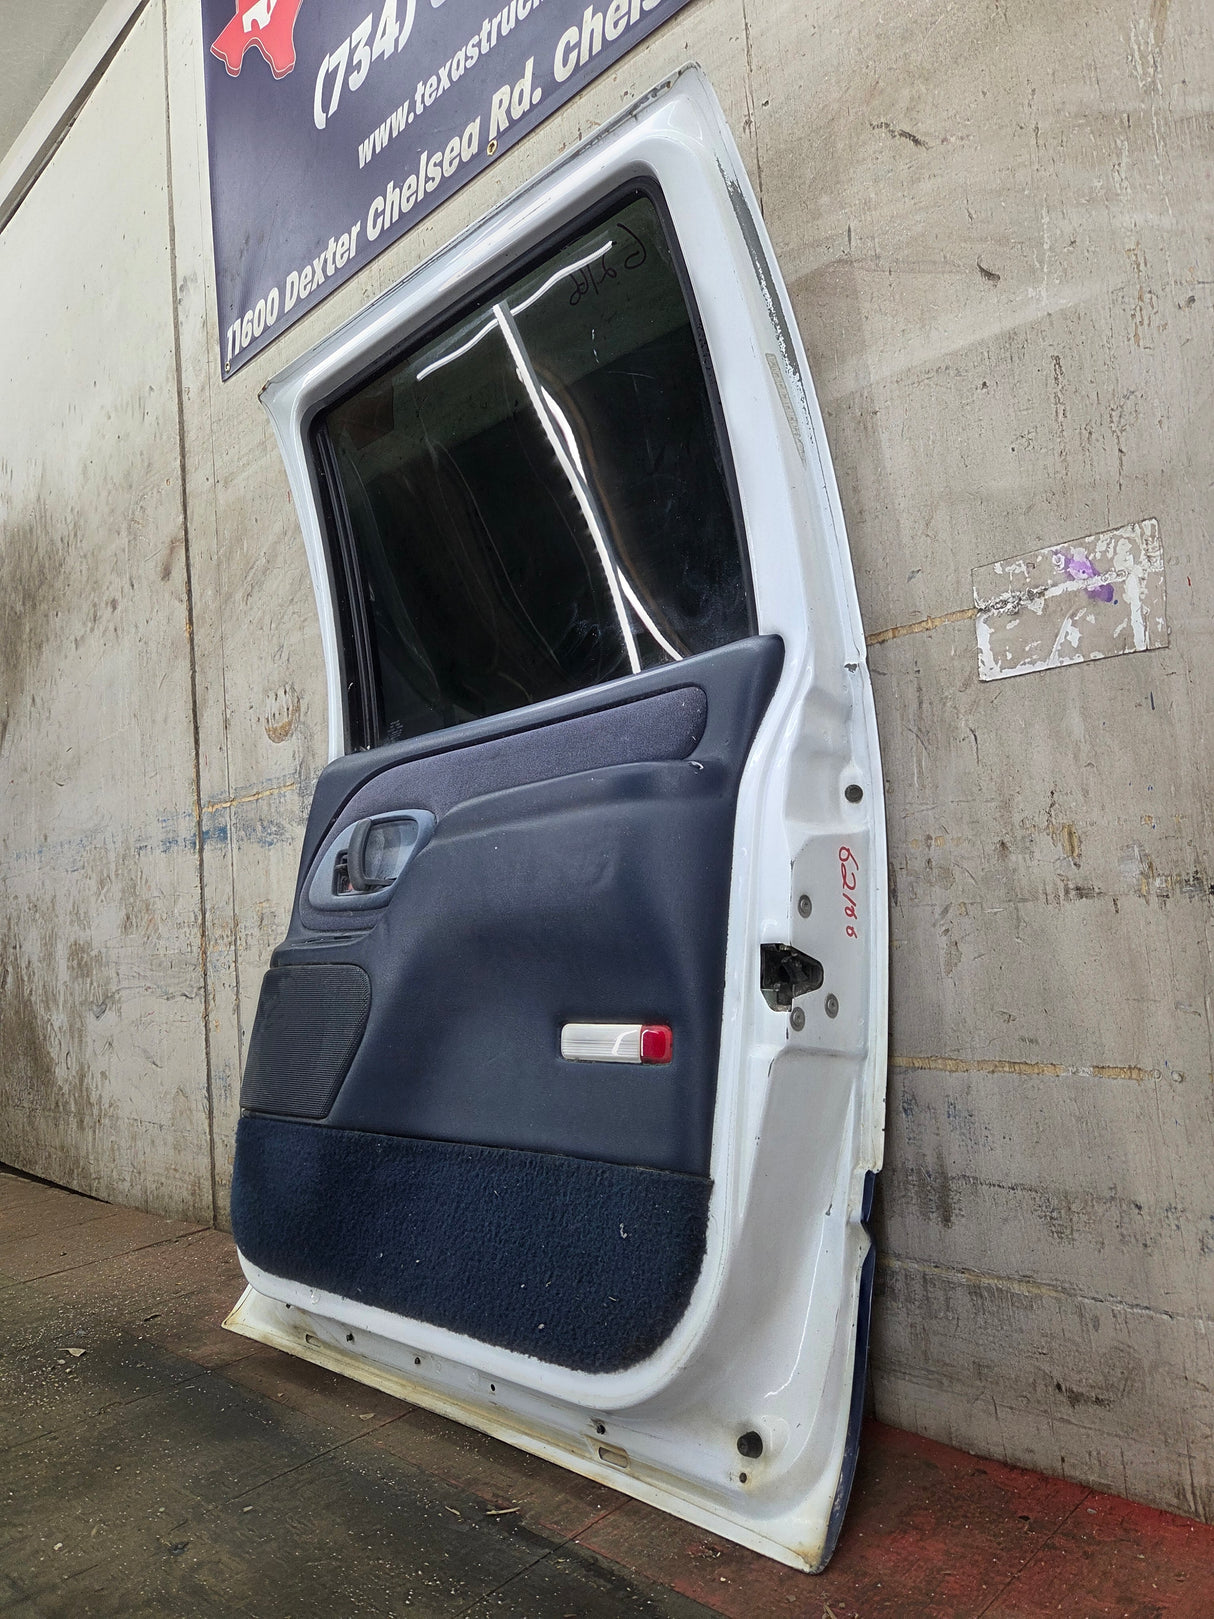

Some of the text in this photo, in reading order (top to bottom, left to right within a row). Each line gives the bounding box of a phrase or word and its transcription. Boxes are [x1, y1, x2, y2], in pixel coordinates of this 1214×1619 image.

[313, 0, 416, 129] (734)
[358, 0, 543, 169] www.texastruc
[227, 287, 279, 362] 11600
[284, 220, 361, 313] Dexter
[366, 116, 481, 241] Chelsea
[488, 56, 543, 141] Rd.
